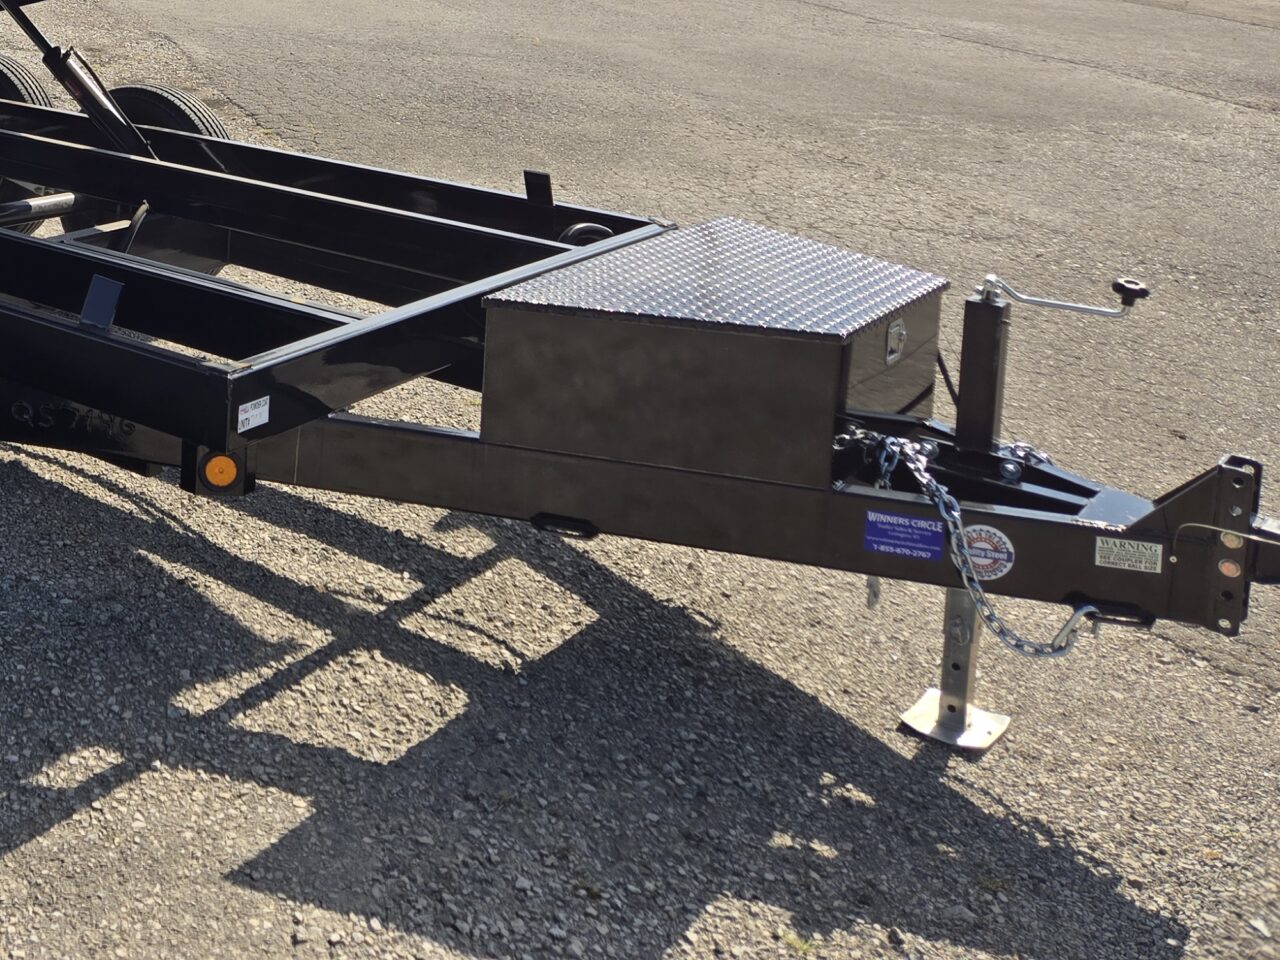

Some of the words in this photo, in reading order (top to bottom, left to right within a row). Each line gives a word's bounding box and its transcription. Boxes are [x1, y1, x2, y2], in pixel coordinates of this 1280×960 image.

[867, 511, 909, 526] WINNERS
[910, 519, 943, 533] CIRCLE
[1100, 538, 1158, 553] WARNING
